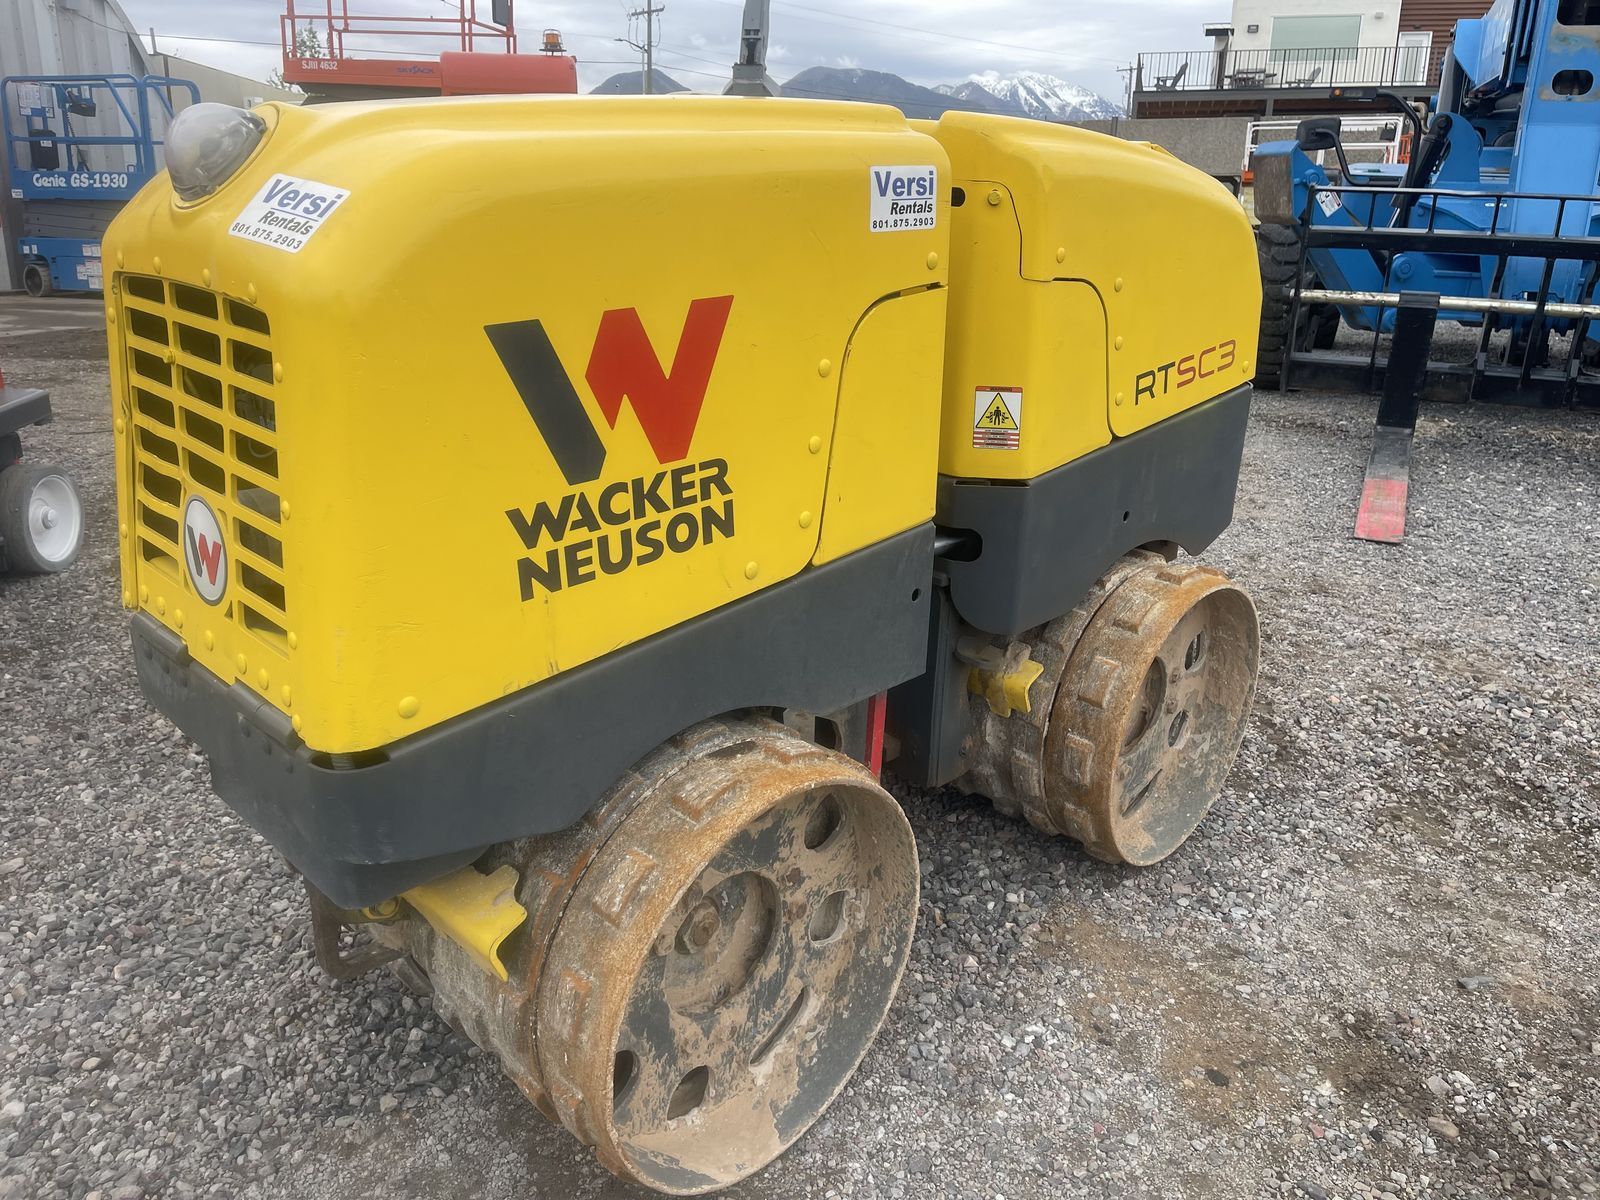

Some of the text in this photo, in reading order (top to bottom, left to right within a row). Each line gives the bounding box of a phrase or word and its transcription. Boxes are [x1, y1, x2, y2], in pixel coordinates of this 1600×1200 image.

[319, 61, 338, 70] 4632
[33, 173, 128, 188] Genie GS-1930
[874, 170, 934, 197] Versi
[262, 178, 344, 218] Versi
[890, 200, 933, 215] Rentals
[232, 222, 303, 250] 801.875.2903
[258, 210, 314, 235] Rentals
[872, 217, 934, 229] 801.875.2903
[1135, 339, 1236, 406] RTSC3
[504, 457, 734, 550] WACKER
[516, 498, 735, 603] NEUSON
